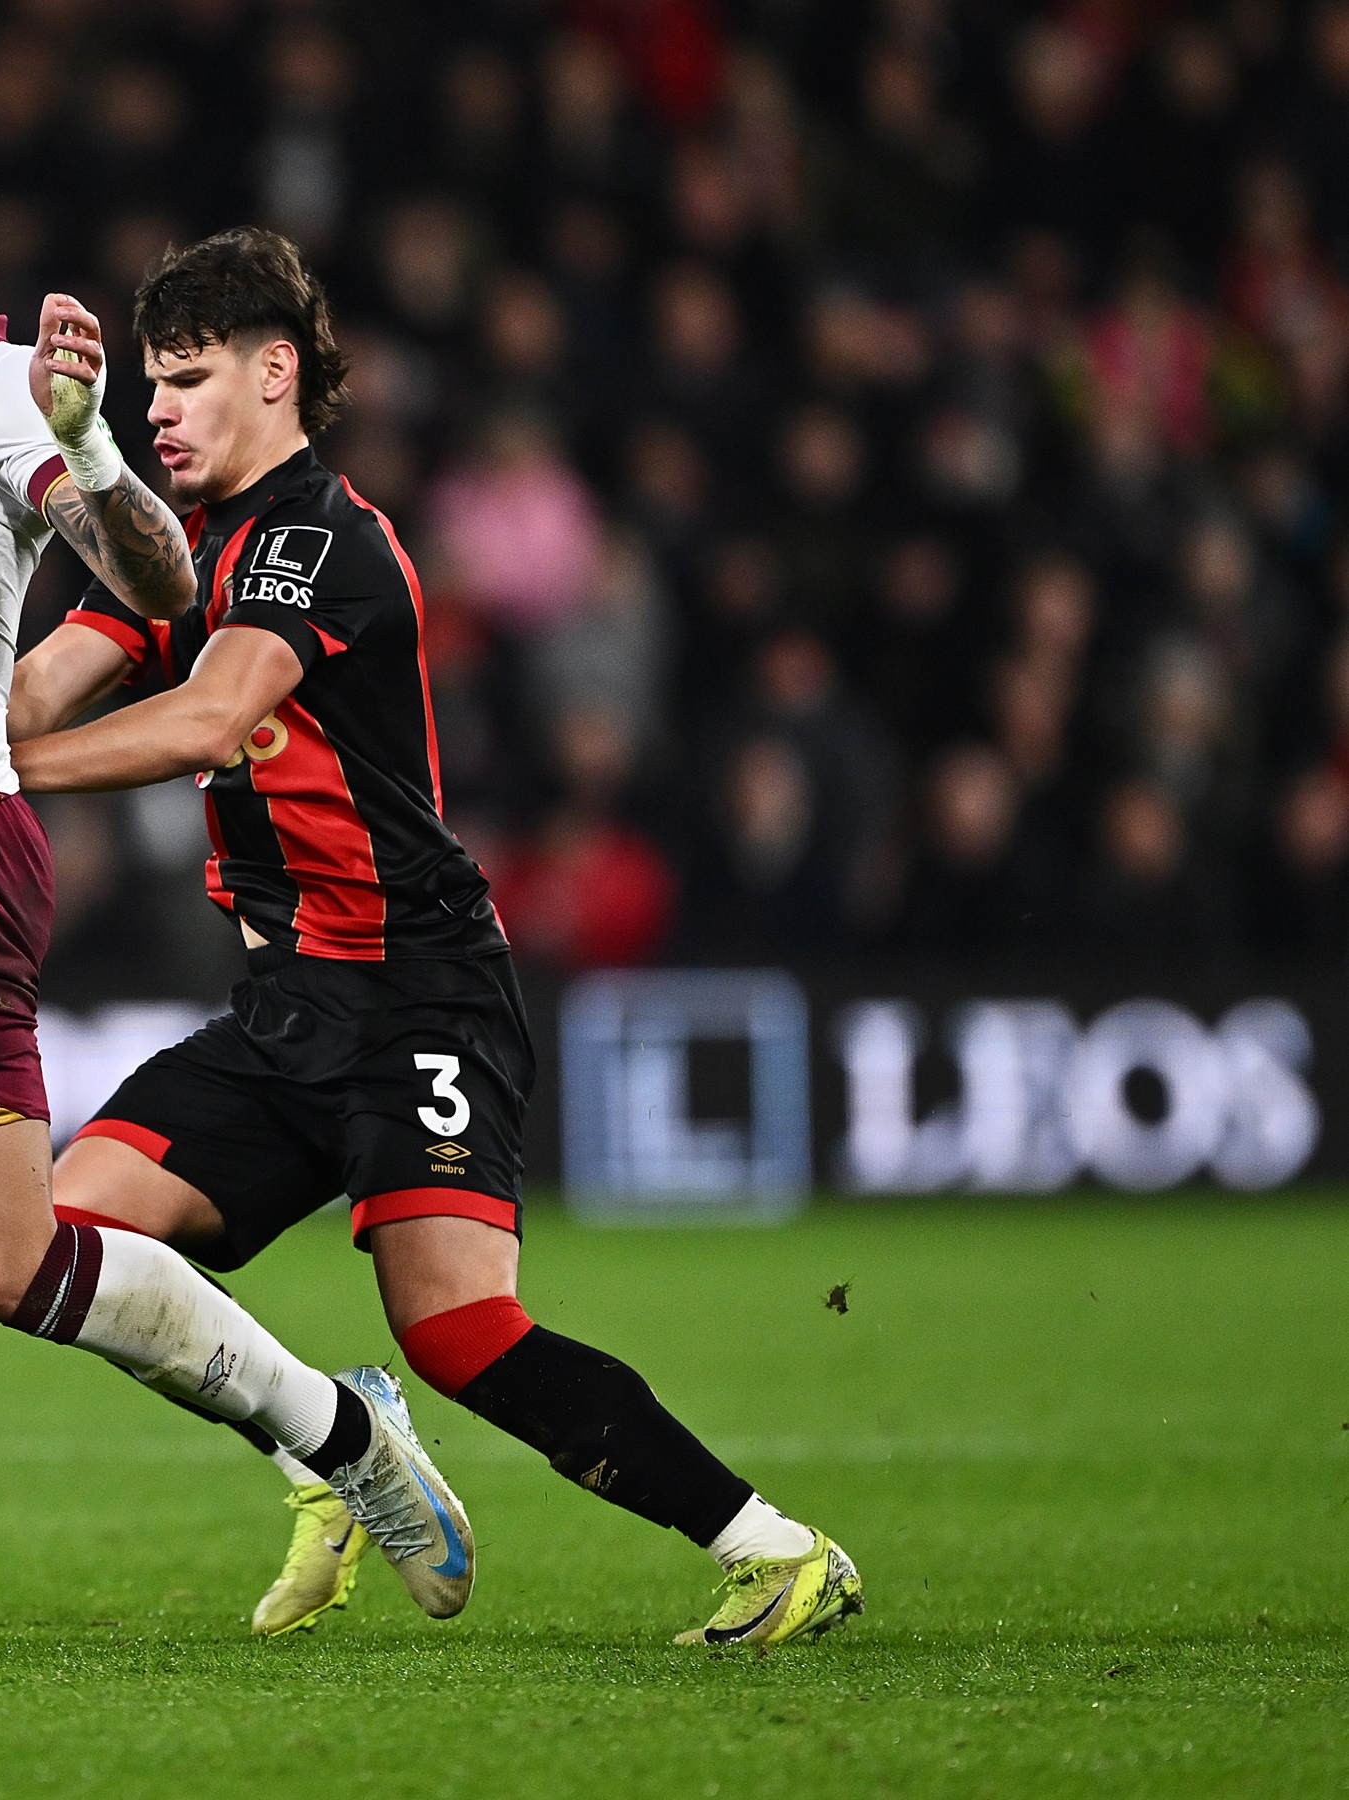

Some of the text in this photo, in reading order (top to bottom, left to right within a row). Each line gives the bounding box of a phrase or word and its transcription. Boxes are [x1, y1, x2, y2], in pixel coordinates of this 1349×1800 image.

[239, 576, 314, 610] LEOS
[413, 1053, 471, 1137] 3
[841, 1000, 1319, 1195] LEOS
[430, 1163, 466, 1175] umbro
[210, 1353, 237, 1397] umbro
